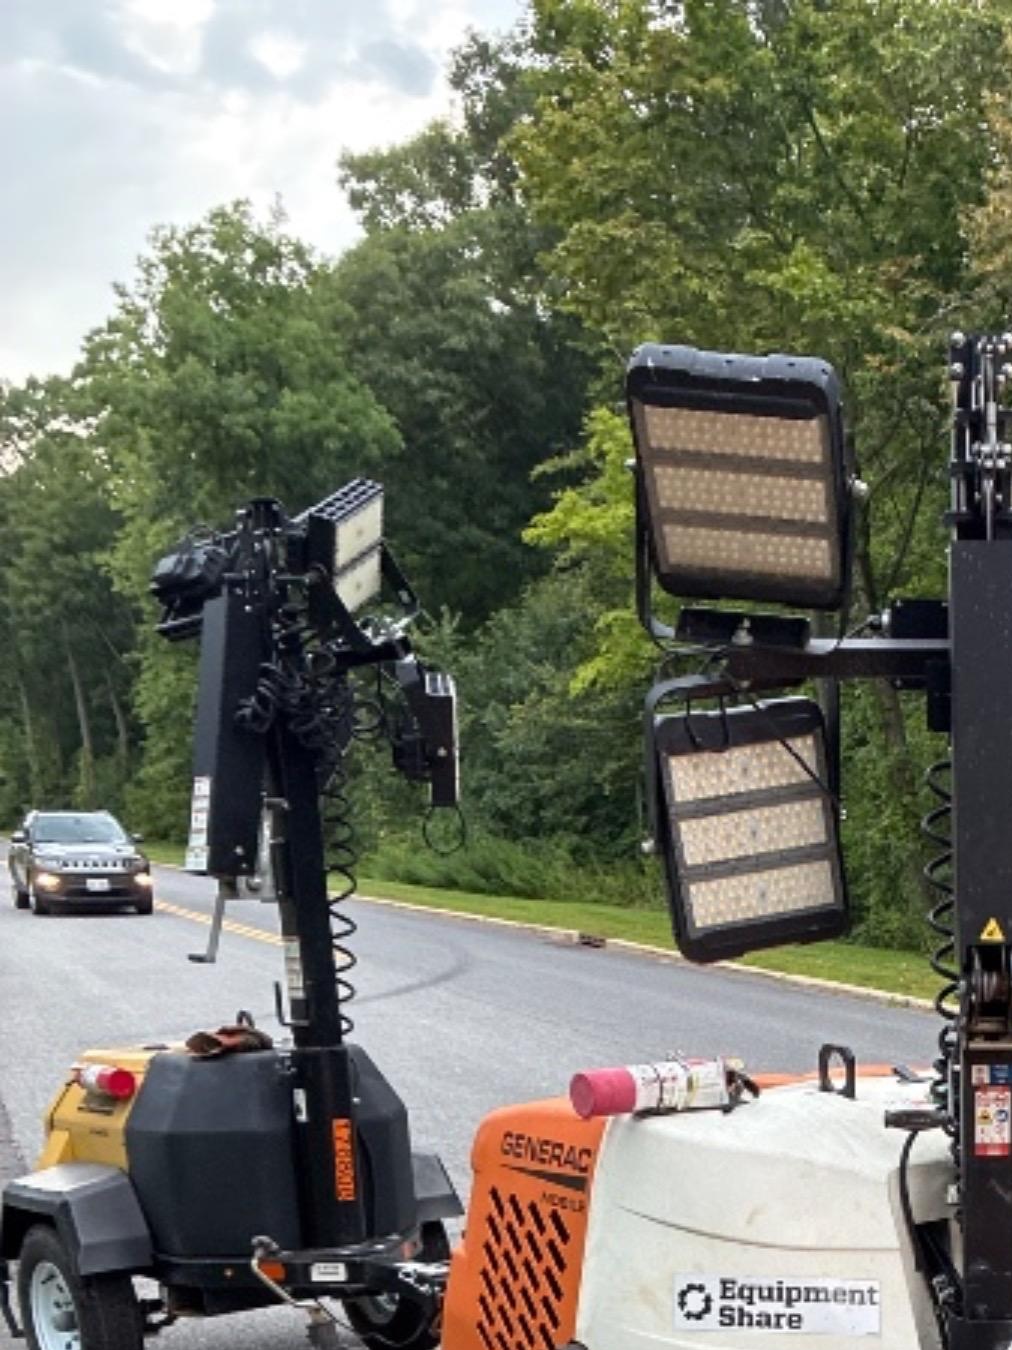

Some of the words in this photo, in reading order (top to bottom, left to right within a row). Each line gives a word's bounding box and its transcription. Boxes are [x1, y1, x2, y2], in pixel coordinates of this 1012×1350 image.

[502, 1131, 592, 1173] GENERAC
[719, 1277, 879, 1308] Equipment
[718, 1304, 803, 1330] Share
